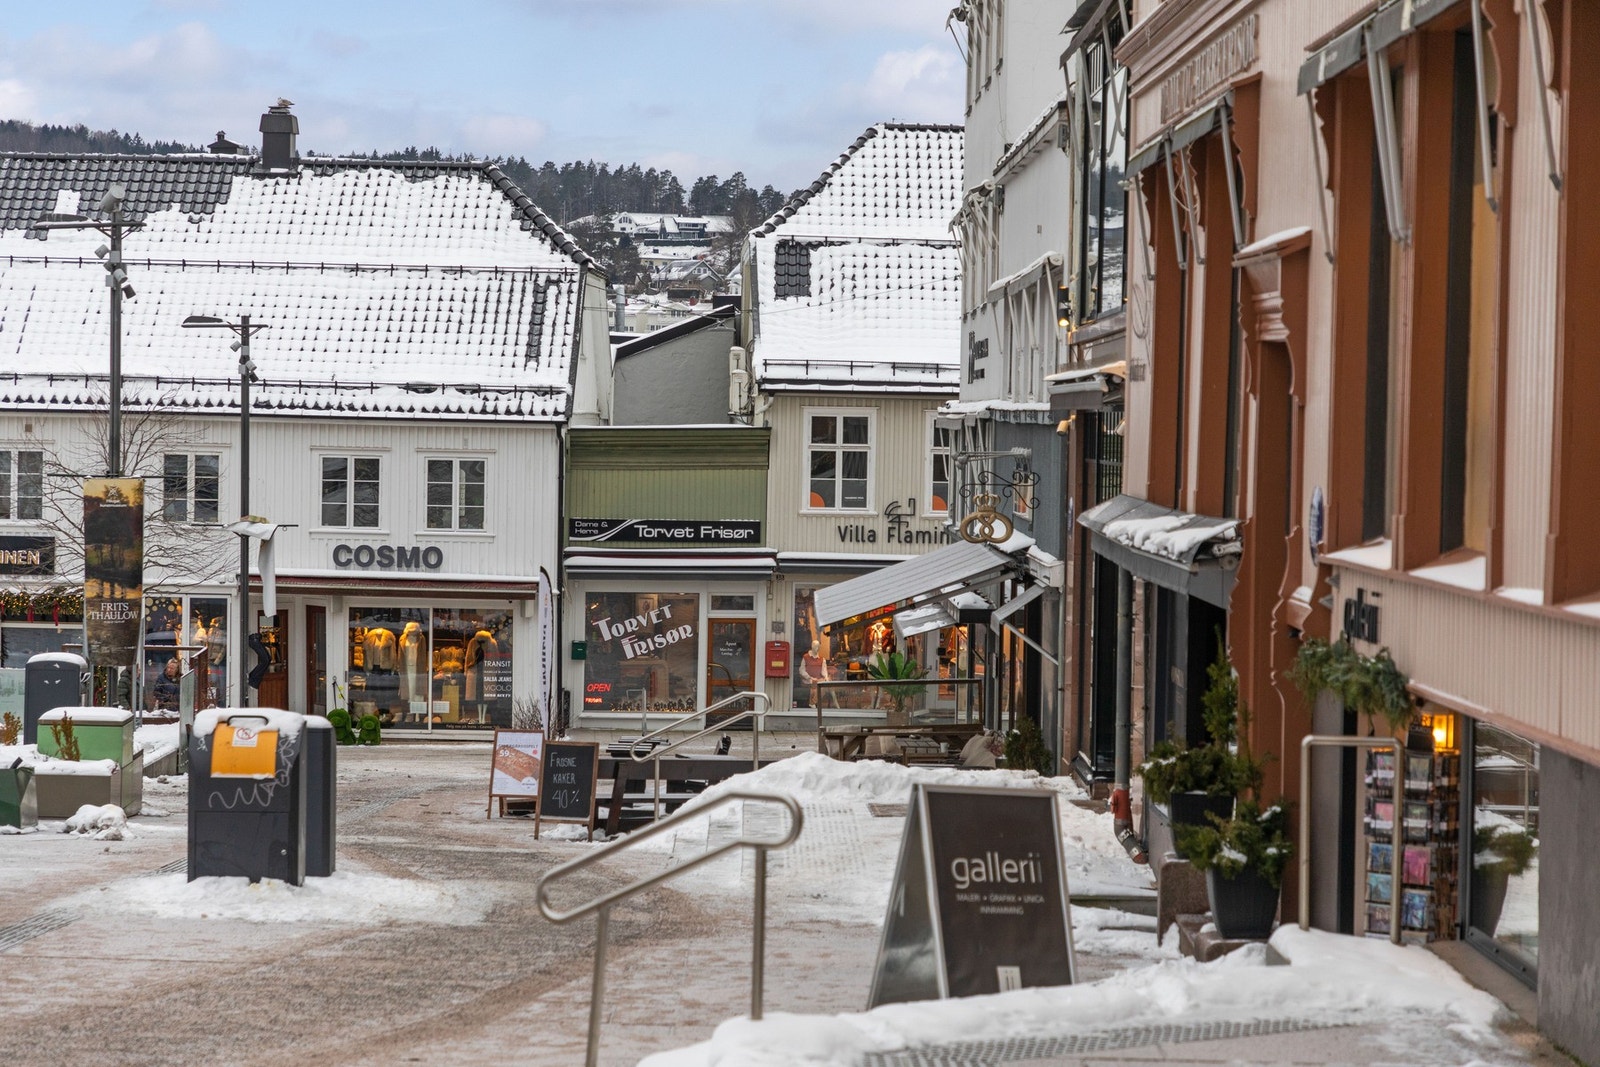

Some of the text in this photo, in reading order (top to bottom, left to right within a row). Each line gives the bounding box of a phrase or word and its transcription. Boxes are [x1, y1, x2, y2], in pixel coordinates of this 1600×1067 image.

[633, 524, 755, 540] Torvet Frisør
[837, 523, 877, 543] Villa
[332, 543, 444, 570] COSMO
[101, 602, 129, 611] FRITS
[91, 610, 140, 620] THAULOW
[484, 660, 511, 668] TRANSIT
[484, 684, 512, 692] VICOLO
[586, 683, 611, 692] OPEN
[552, 772, 576, 785] KAKER
